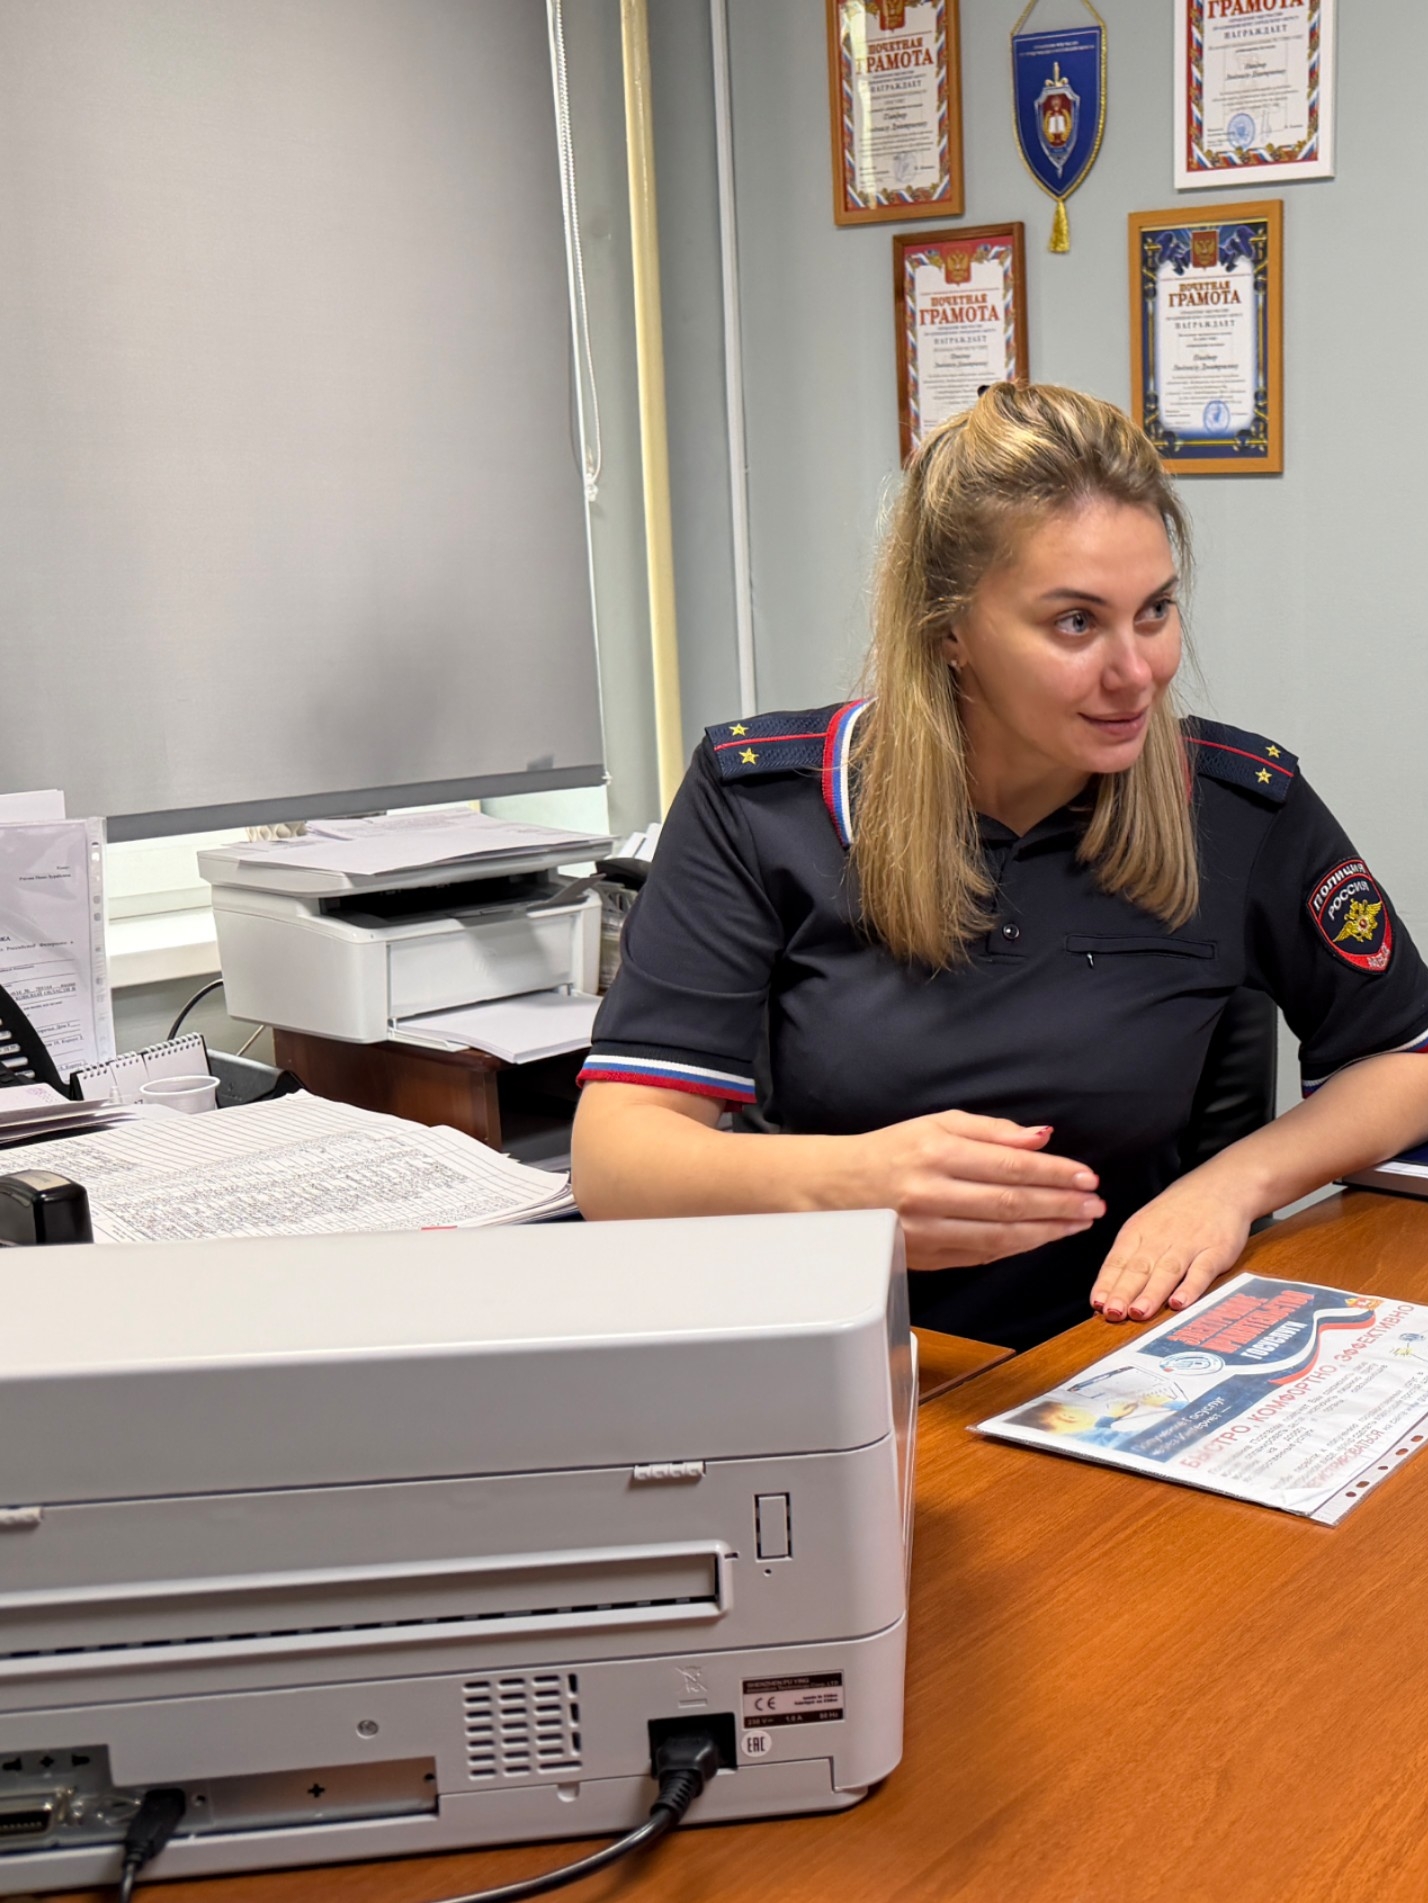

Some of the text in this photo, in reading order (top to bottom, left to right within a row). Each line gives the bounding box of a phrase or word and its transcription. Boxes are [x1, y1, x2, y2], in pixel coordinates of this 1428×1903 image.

[1224, 24, 1288, 39] НАГРАЖДАЕТ
[868, 37, 923, 54] ПОЧЕТНАЯ
[856, 48, 934, 75] ГРАМОТА
[1179, 280, 1231, 292] ПОЧЕТНАЯ
[931, 293, 987, 307] ПОЧЕТНАЯ
[1168, 289, 1242, 308] ГРАМОТА
[919, 304, 1000, 326] ГРАМОТА
[1313, 863, 1367, 911] ПОЛИЦИЯ
[1328, 880, 1370, 921] РОССИЯ
[1240, 1320, 1308, 1360] ГОСУСЛУГИ
[1333, 1304, 1415, 1362] ЭФФЕКТИВНО
[754, 1696, 776, 1712] CE
[747, 1736, 765, 1753] EAC
